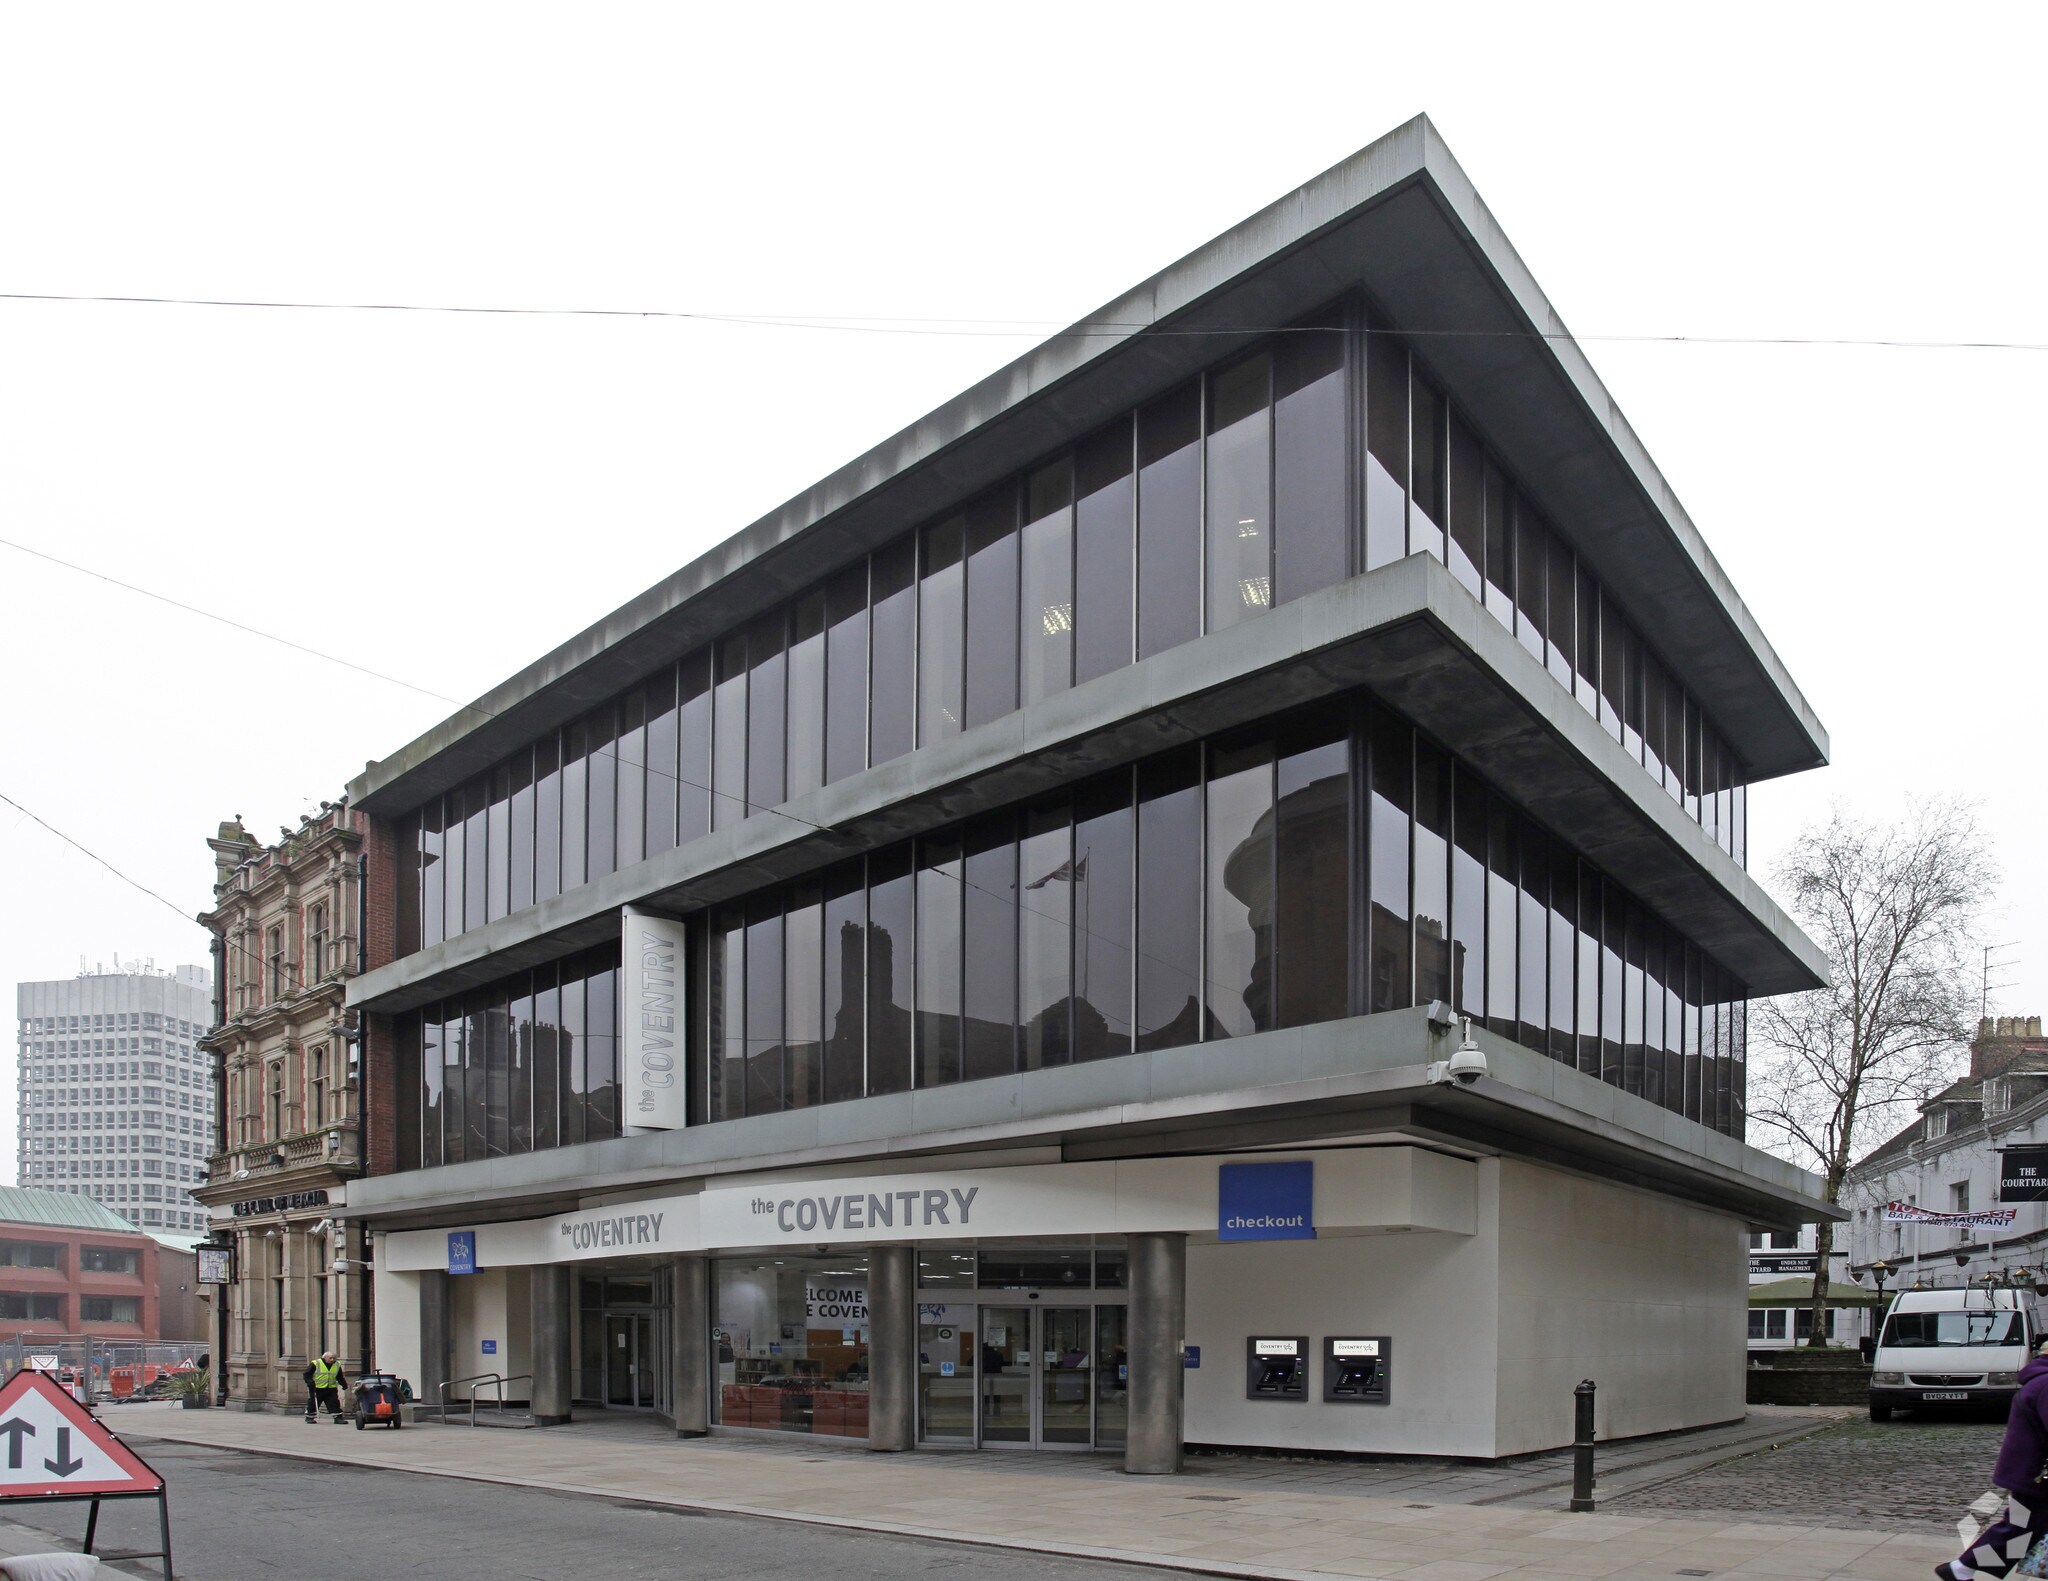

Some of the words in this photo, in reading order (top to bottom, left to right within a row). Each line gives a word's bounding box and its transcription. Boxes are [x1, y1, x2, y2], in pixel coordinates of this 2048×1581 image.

[641, 930, 675, 1090] COVENTRY
[639, 1089, 655, 1112] the
[2019, 1167, 2037, 1176] THE
[2001, 1178, 2048, 1187] COURTYAR
[751, 1198, 775, 1214] the
[777, 1187, 980, 1232] COVENTRY
[1888, 1211, 1913, 1219] BAR
[561, 1222, 572, 1236] the
[572, 1213, 664, 1249] COVENTRY
[1226, 1214, 1304, 1229] checkout
